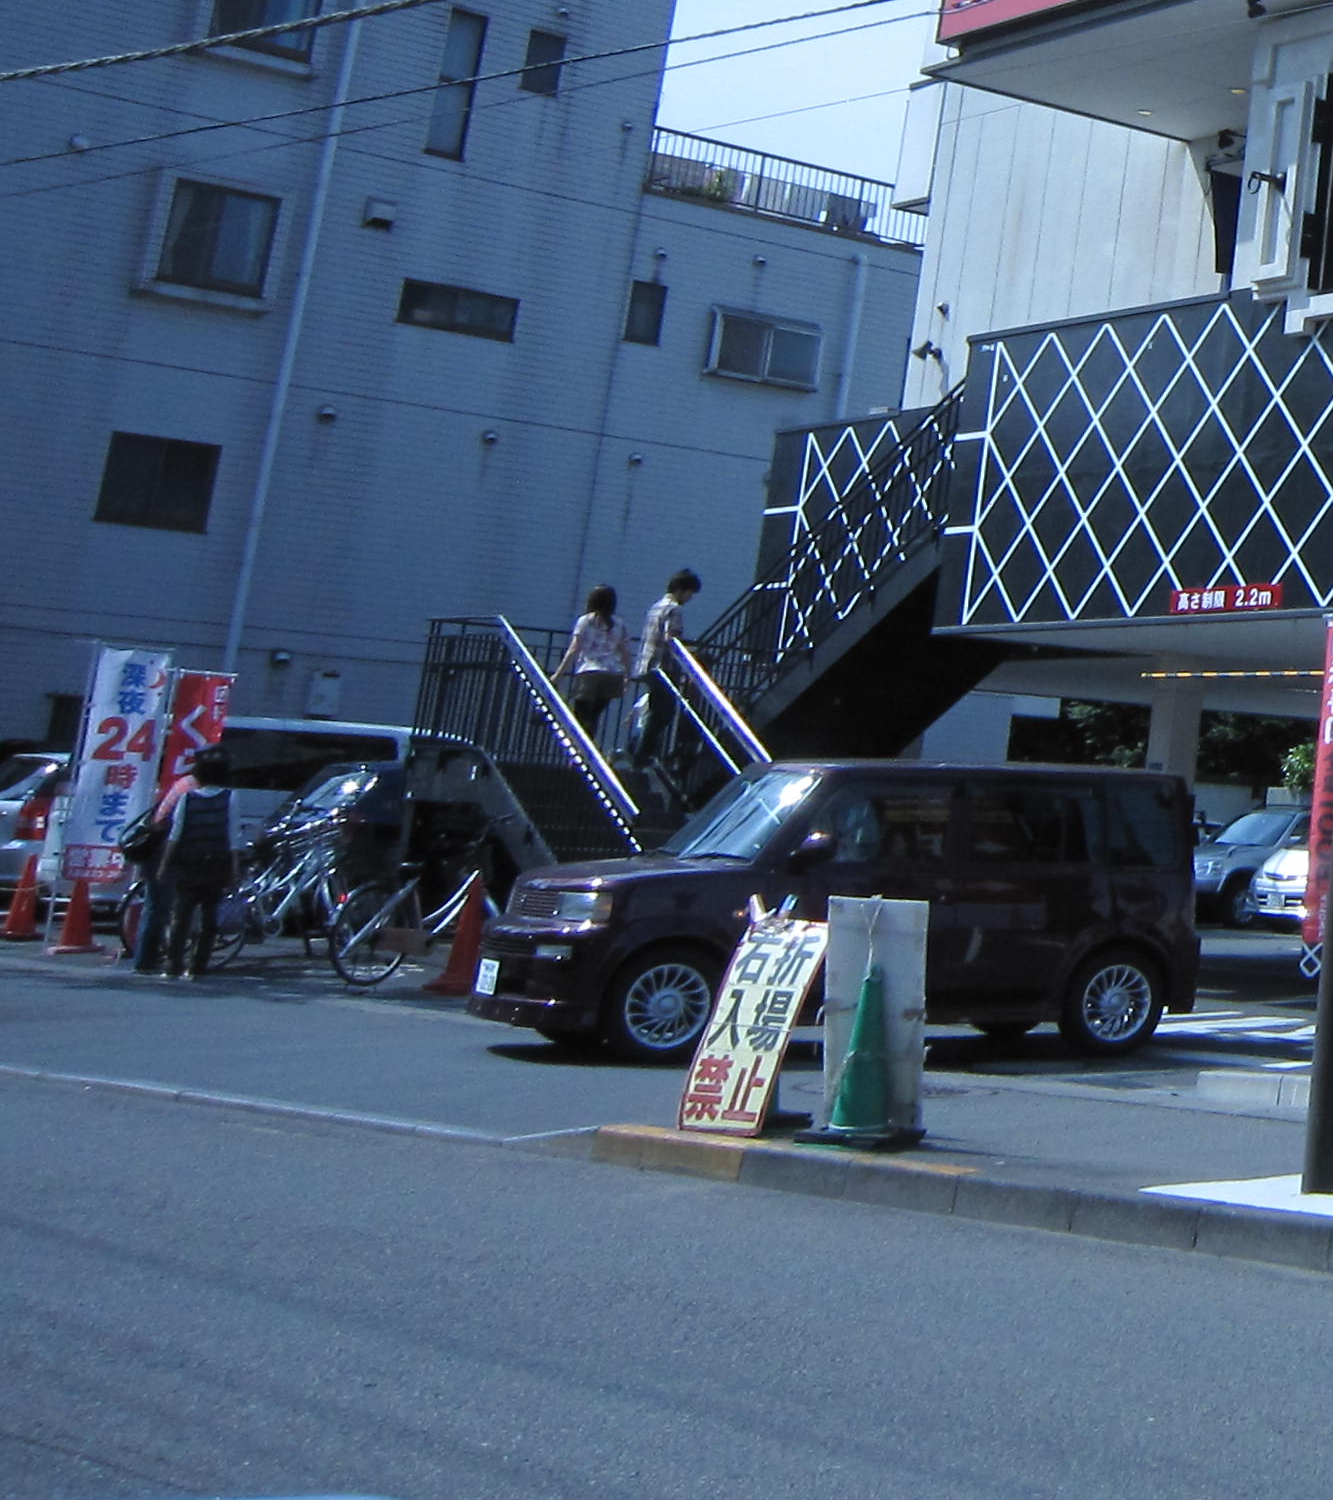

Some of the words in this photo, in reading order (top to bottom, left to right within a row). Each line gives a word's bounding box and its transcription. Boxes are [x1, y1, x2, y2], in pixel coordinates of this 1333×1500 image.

[1176, 591, 1225, 611] 高さ制限
[1234, 588, 1272, 608] 2.2m
[734, 934, 822, 987] 右折
[706, 988, 797, 1052] 入場
[684, 1053, 767, 1123] 禁止
